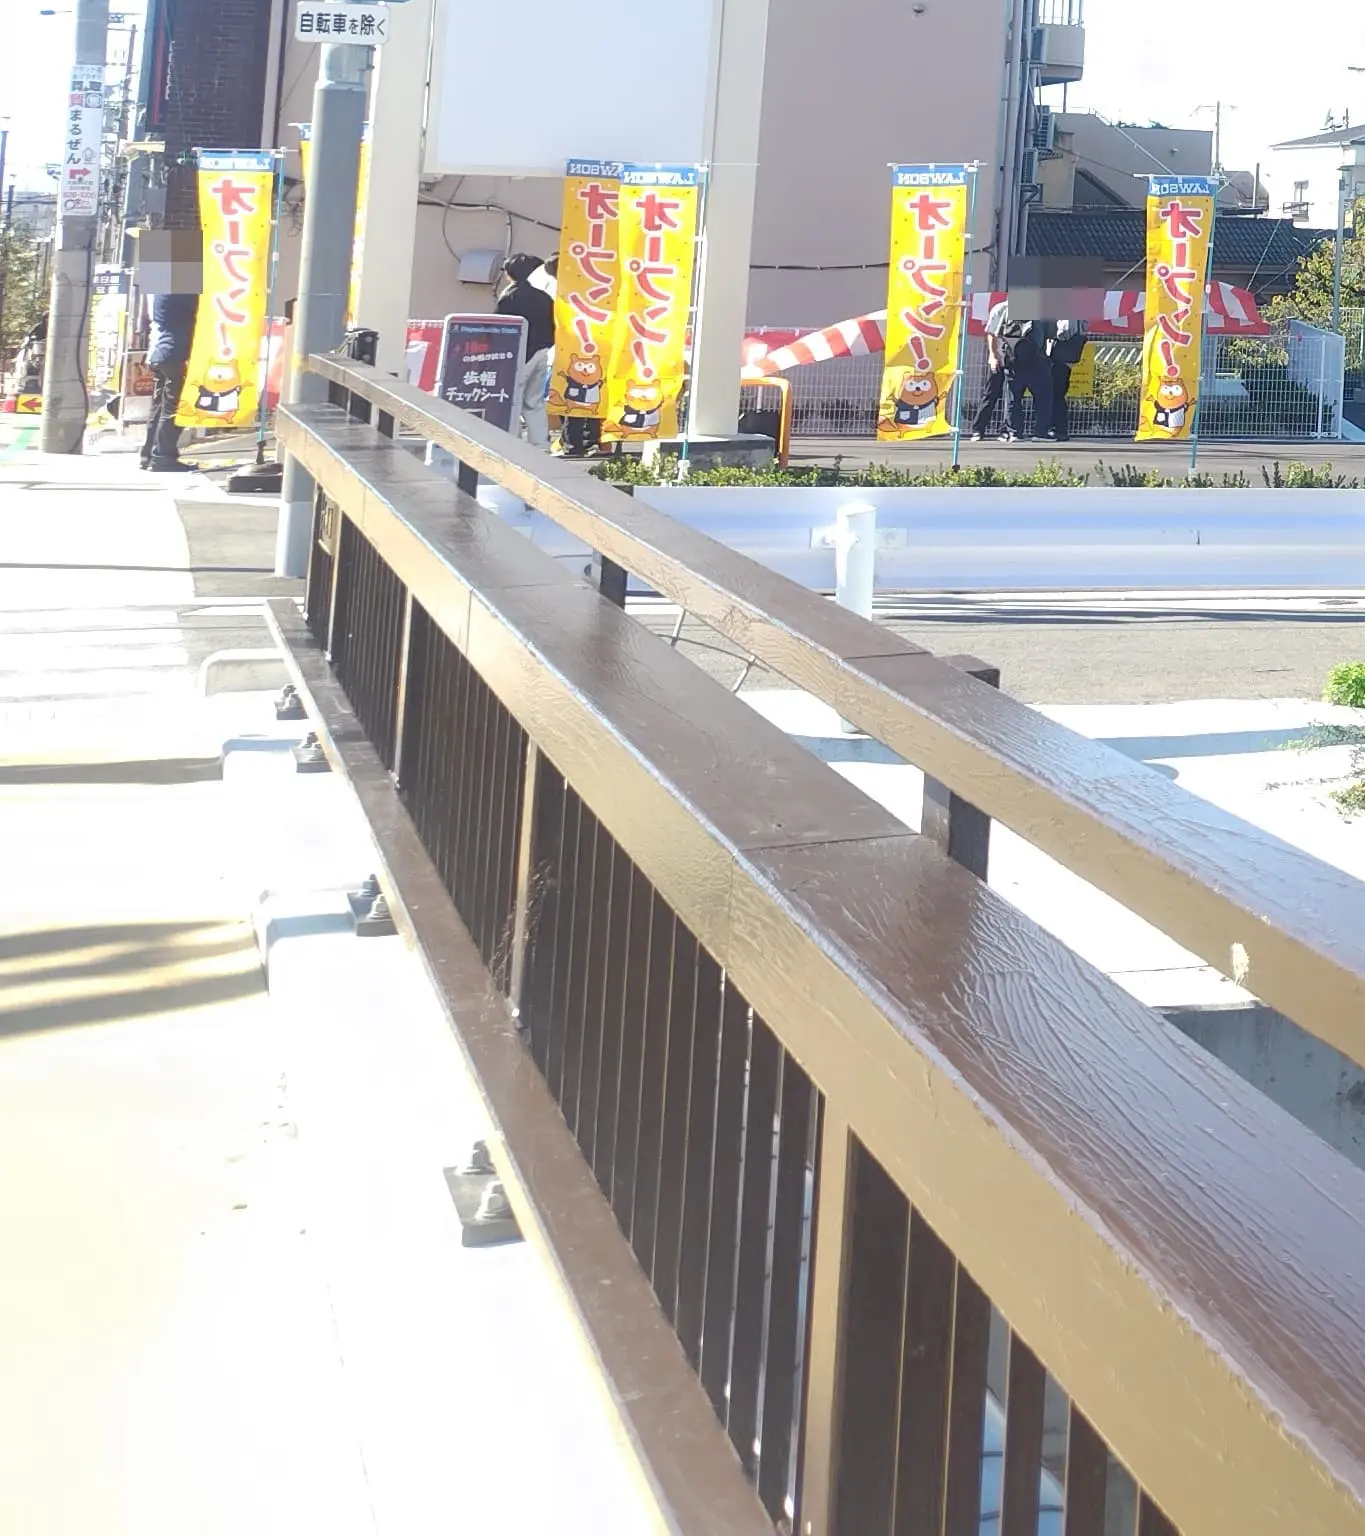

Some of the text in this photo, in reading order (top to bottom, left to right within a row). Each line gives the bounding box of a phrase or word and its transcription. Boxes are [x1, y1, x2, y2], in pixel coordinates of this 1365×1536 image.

[300, 11, 386, 36] 自転車を除く
[66, 109, 82, 164] まるぜん
[463, 370, 497, 386] 歩幅
[445, 386, 510, 402] チェックシート
